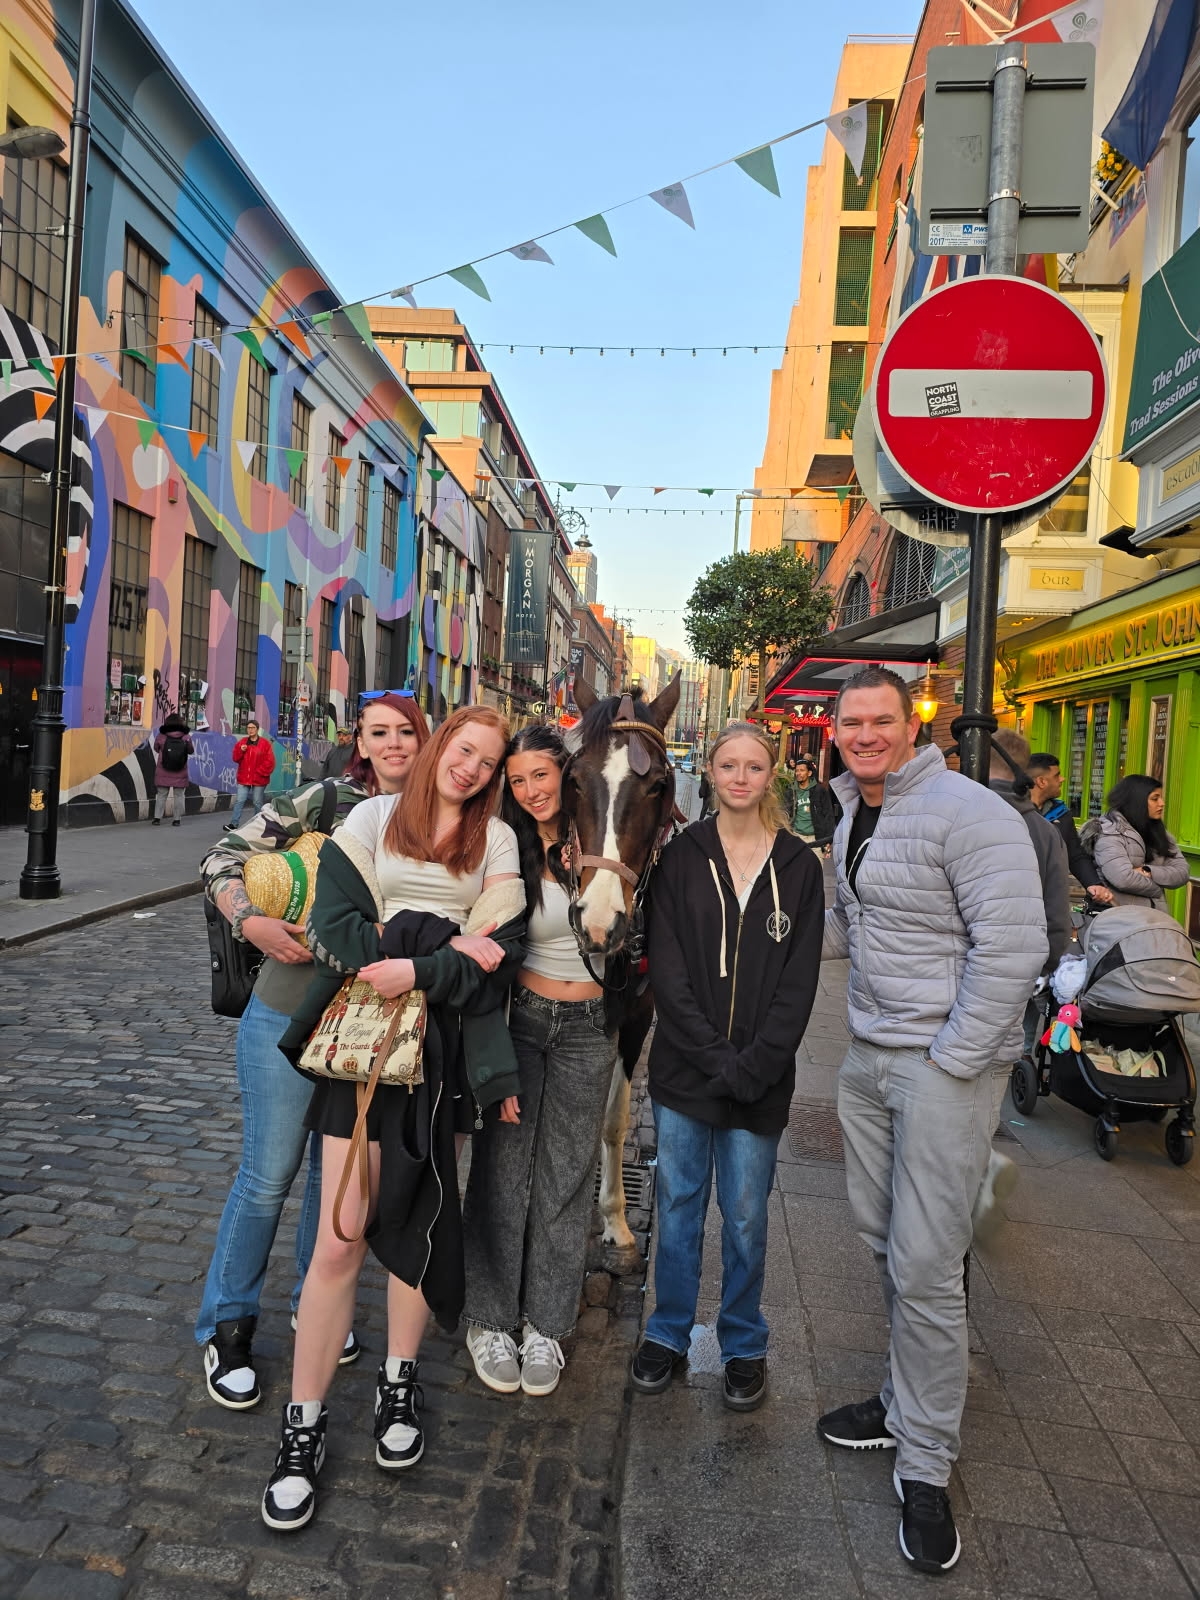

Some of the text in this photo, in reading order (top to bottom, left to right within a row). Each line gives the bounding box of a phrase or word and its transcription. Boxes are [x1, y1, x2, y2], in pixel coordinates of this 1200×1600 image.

[930, 238, 944, 246] 2017
[1152, 369, 1173, 396] The
[926, 384, 956, 396] NORTH
[928, 392, 957, 405] COAST
[930, 406, 960, 416] GRAPPLING
[1130, 375, 1199, 436] Trad Sessions
[522, 548, 534, 609] MORGAN
[1036, 600, 1200, 681] THE OLIVER ST. JOHN
[750, 681, 758, 694] INN
[788, 712, 830, 725] Cocktails
[290, 896, 299, 906] Day
[345, 1022, 376, 1042] Royal
